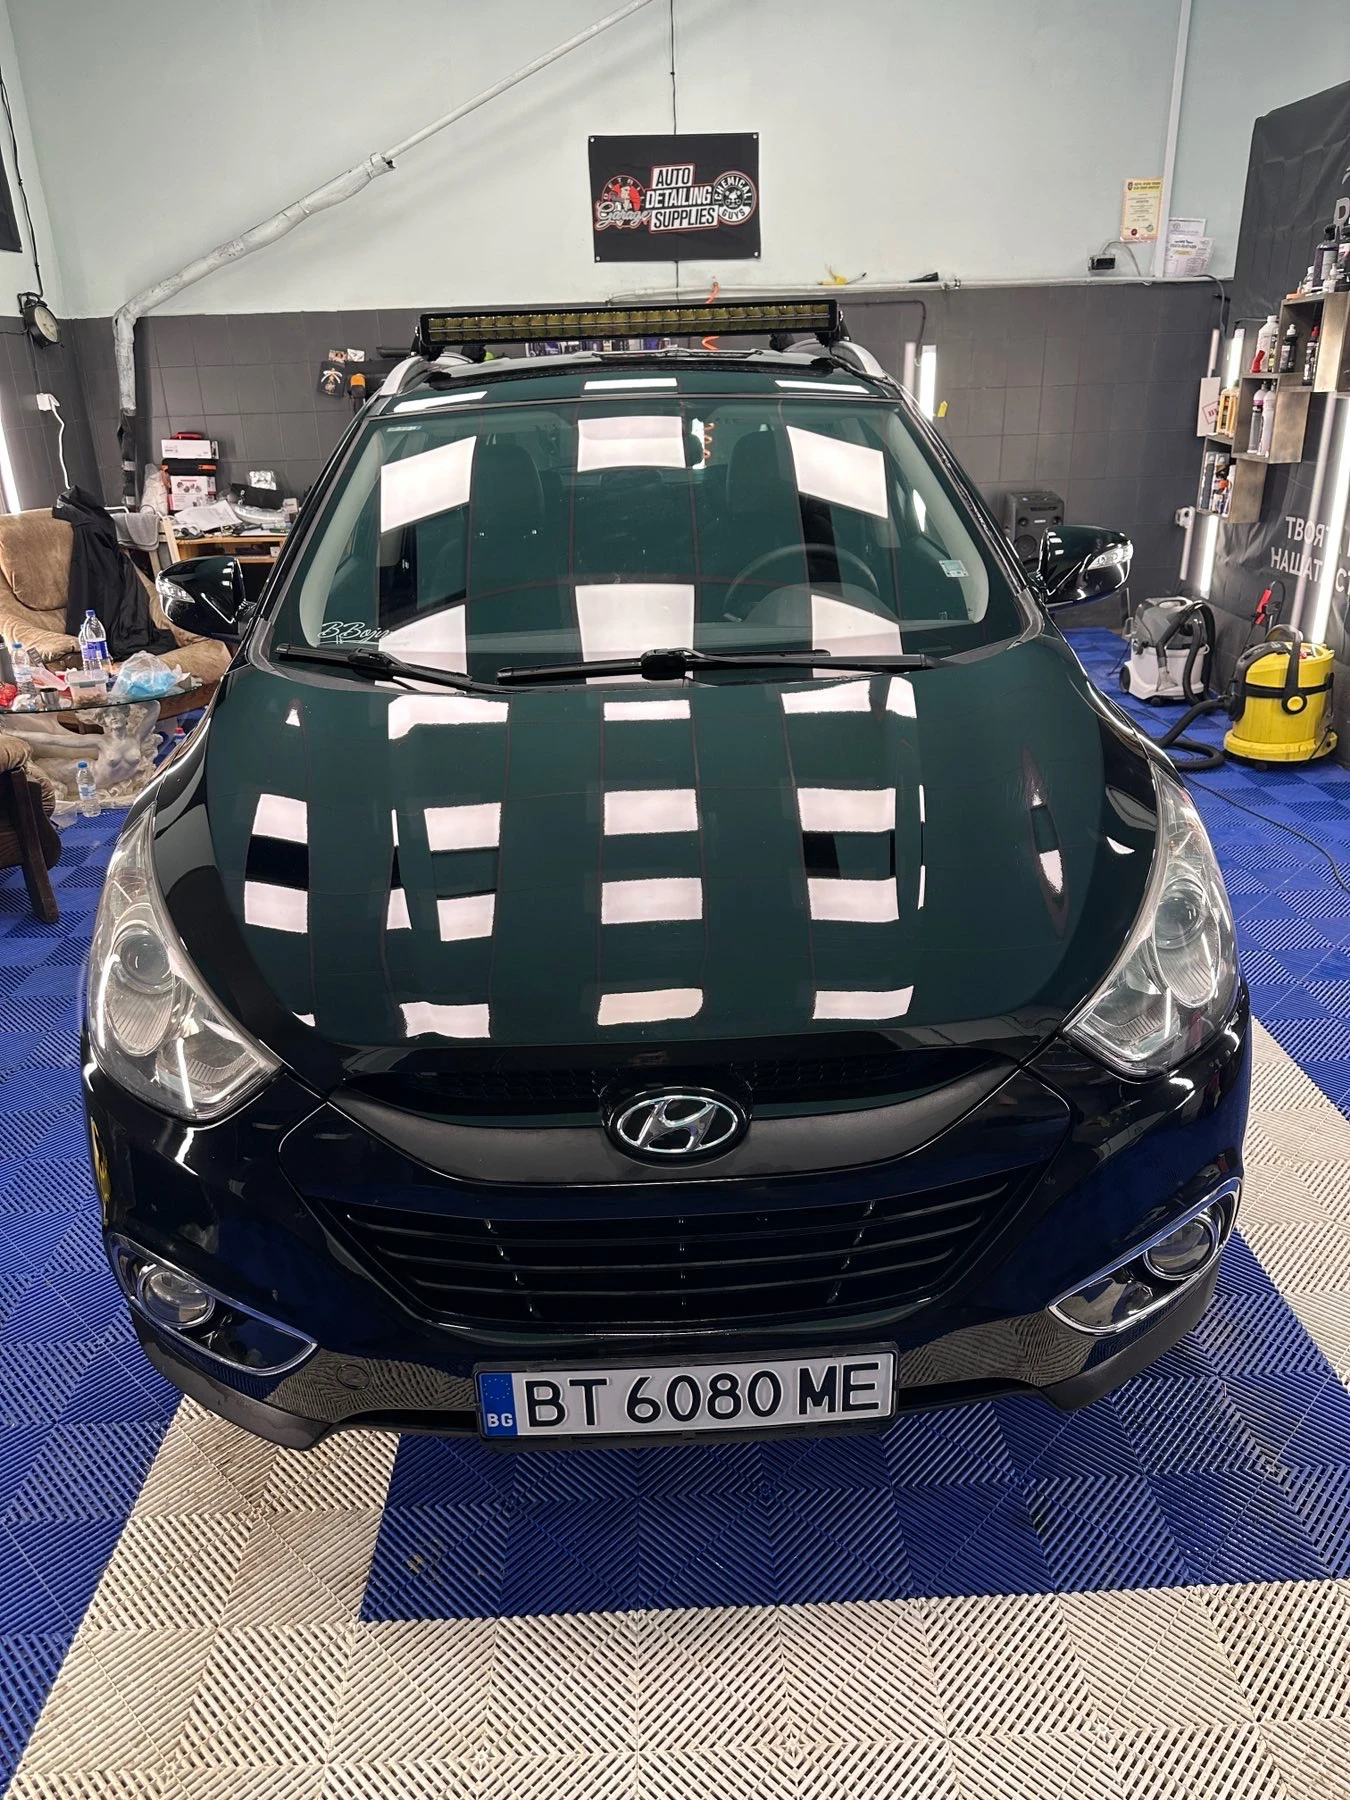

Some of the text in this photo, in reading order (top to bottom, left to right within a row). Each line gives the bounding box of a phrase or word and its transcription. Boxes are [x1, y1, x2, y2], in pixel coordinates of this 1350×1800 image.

[655, 167, 691, 187] AUTO
[715, 176, 752, 200] CHEMICAL
[645, 185, 712, 209] DETAILING
[654, 207, 715, 229] SUPPLIES
[721, 208, 746, 220] GUYS
[524, 1361, 880, 1428] BT 6080 ME
[486, 1412, 513, 1428] BG
